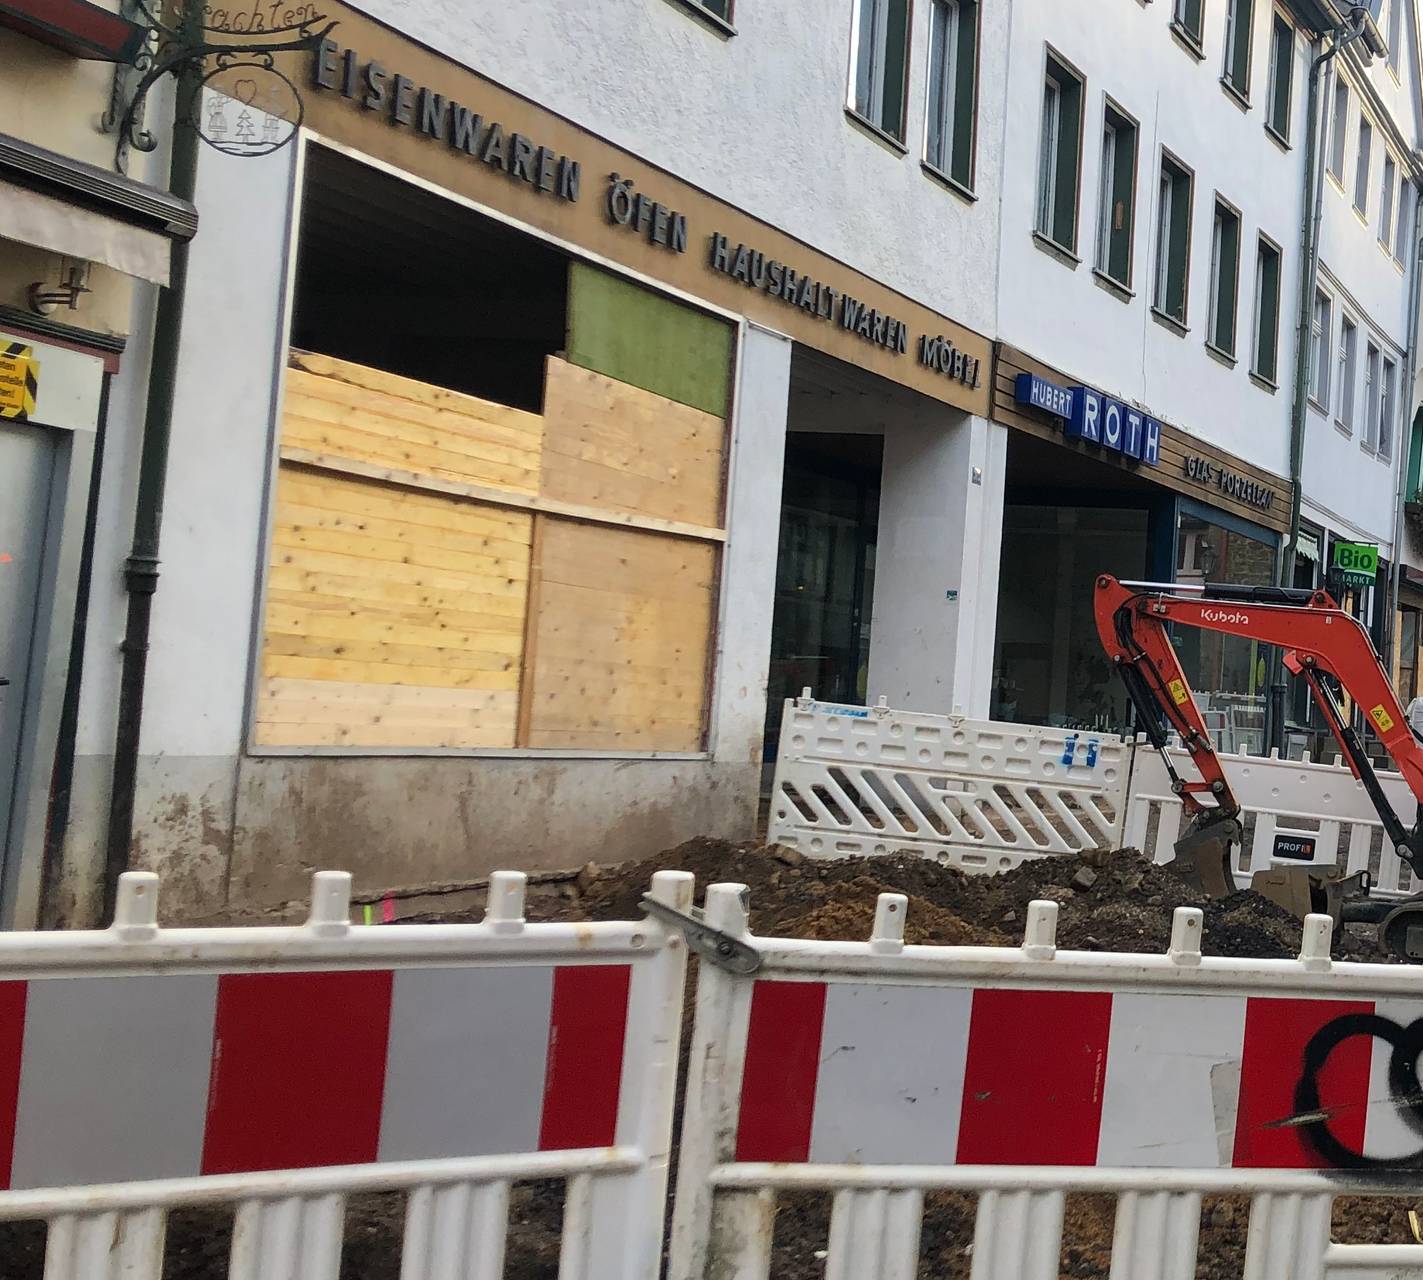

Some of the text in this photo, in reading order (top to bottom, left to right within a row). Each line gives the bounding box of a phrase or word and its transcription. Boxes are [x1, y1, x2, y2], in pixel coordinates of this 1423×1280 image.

[203, 0, 318, 33] achten
[313, 39, 582, 202] EISENWAREN
[607, 172, 688, 253] ÖFEN
[920, 335, 982, 390] MÖBEL
[1031, 380, 1072, 418] HUBERT
[1084, 394, 1160, 462] ROTH
[1184, 455, 1275, 510] GLAS PORZELLAN
[1339, 548, 1373, 570] Bio
[1200, 608, 1249, 625] Kubota
